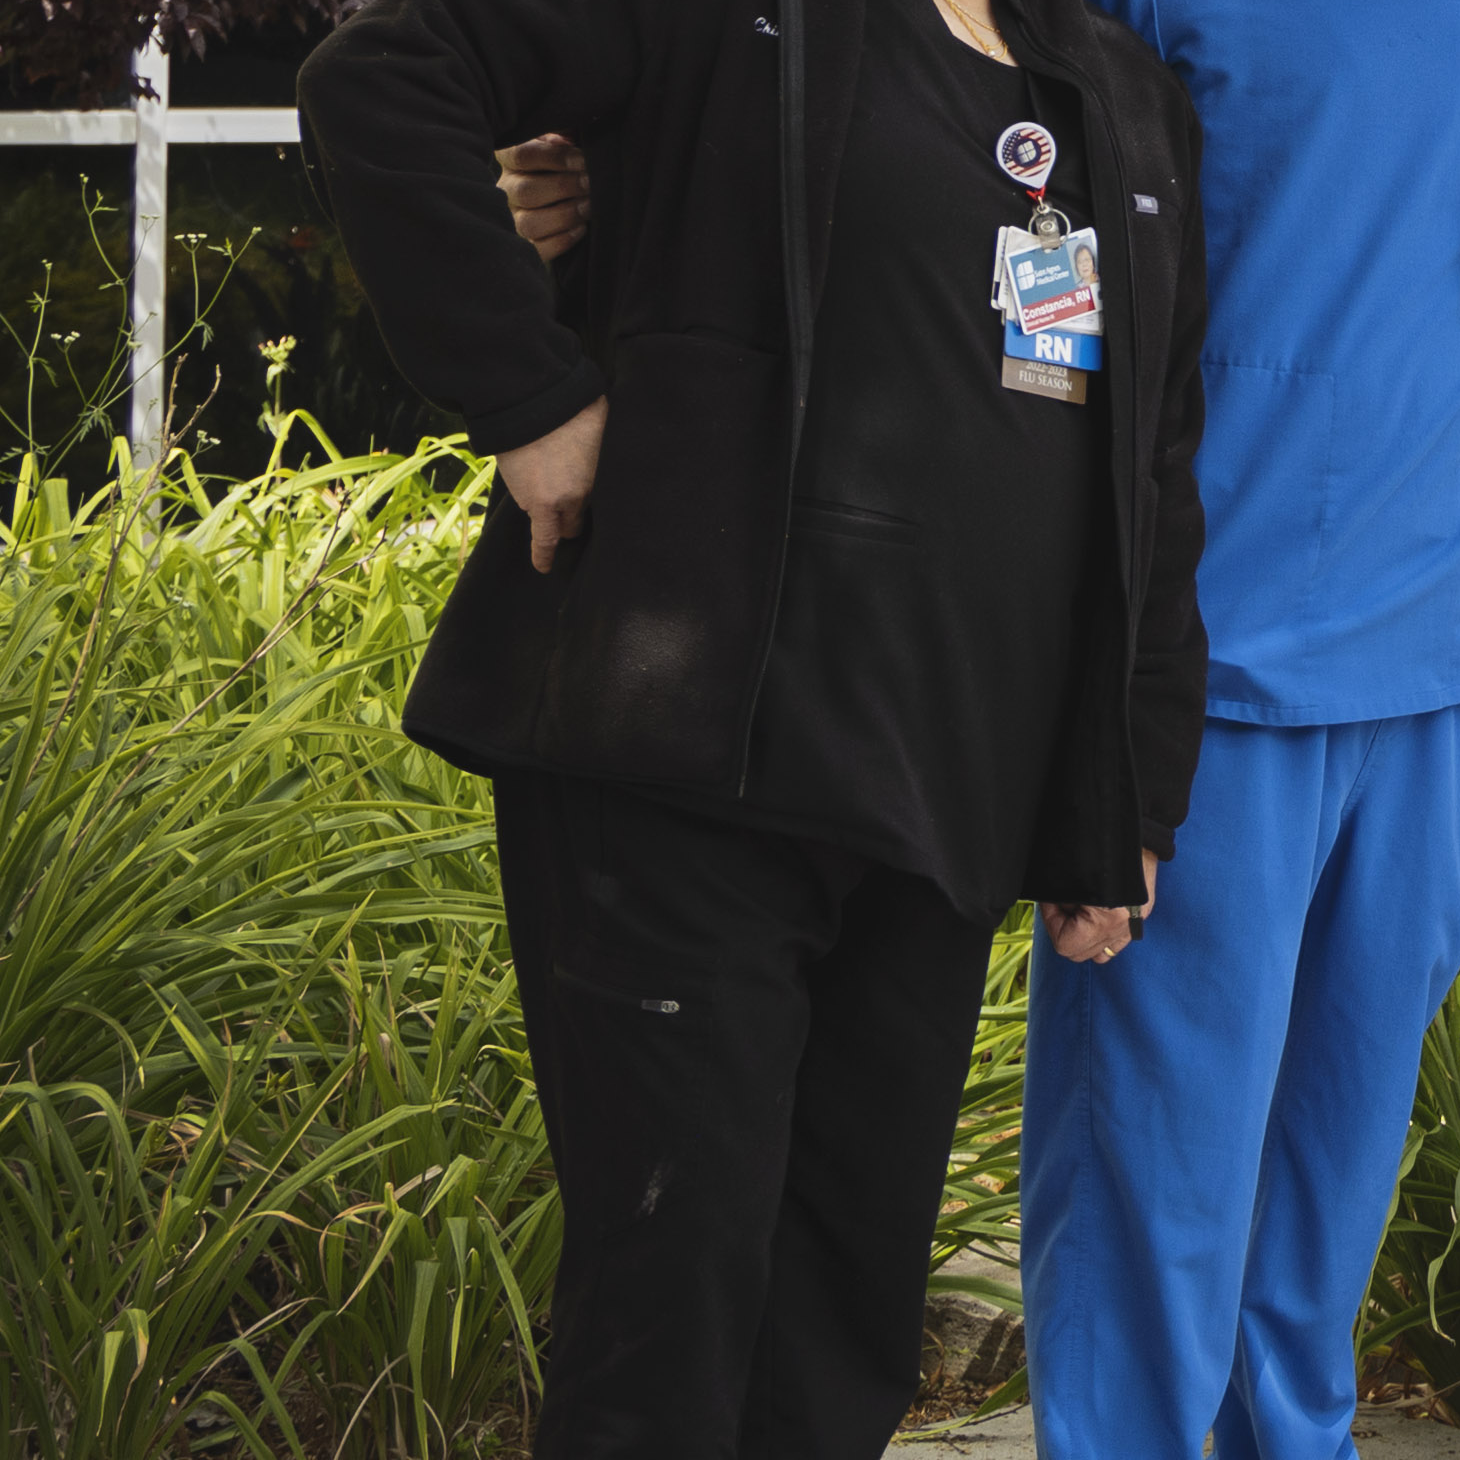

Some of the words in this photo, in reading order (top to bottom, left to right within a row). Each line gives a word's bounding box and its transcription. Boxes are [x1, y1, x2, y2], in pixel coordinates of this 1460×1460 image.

[1022, 296, 1076, 321] Constancia,
[1075, 289, 1091, 304] RN
[1035, 332, 1073, 364] RN
[1019, 370, 1036, 384] FLU
[1037, 374, 1073, 391] SEASON
